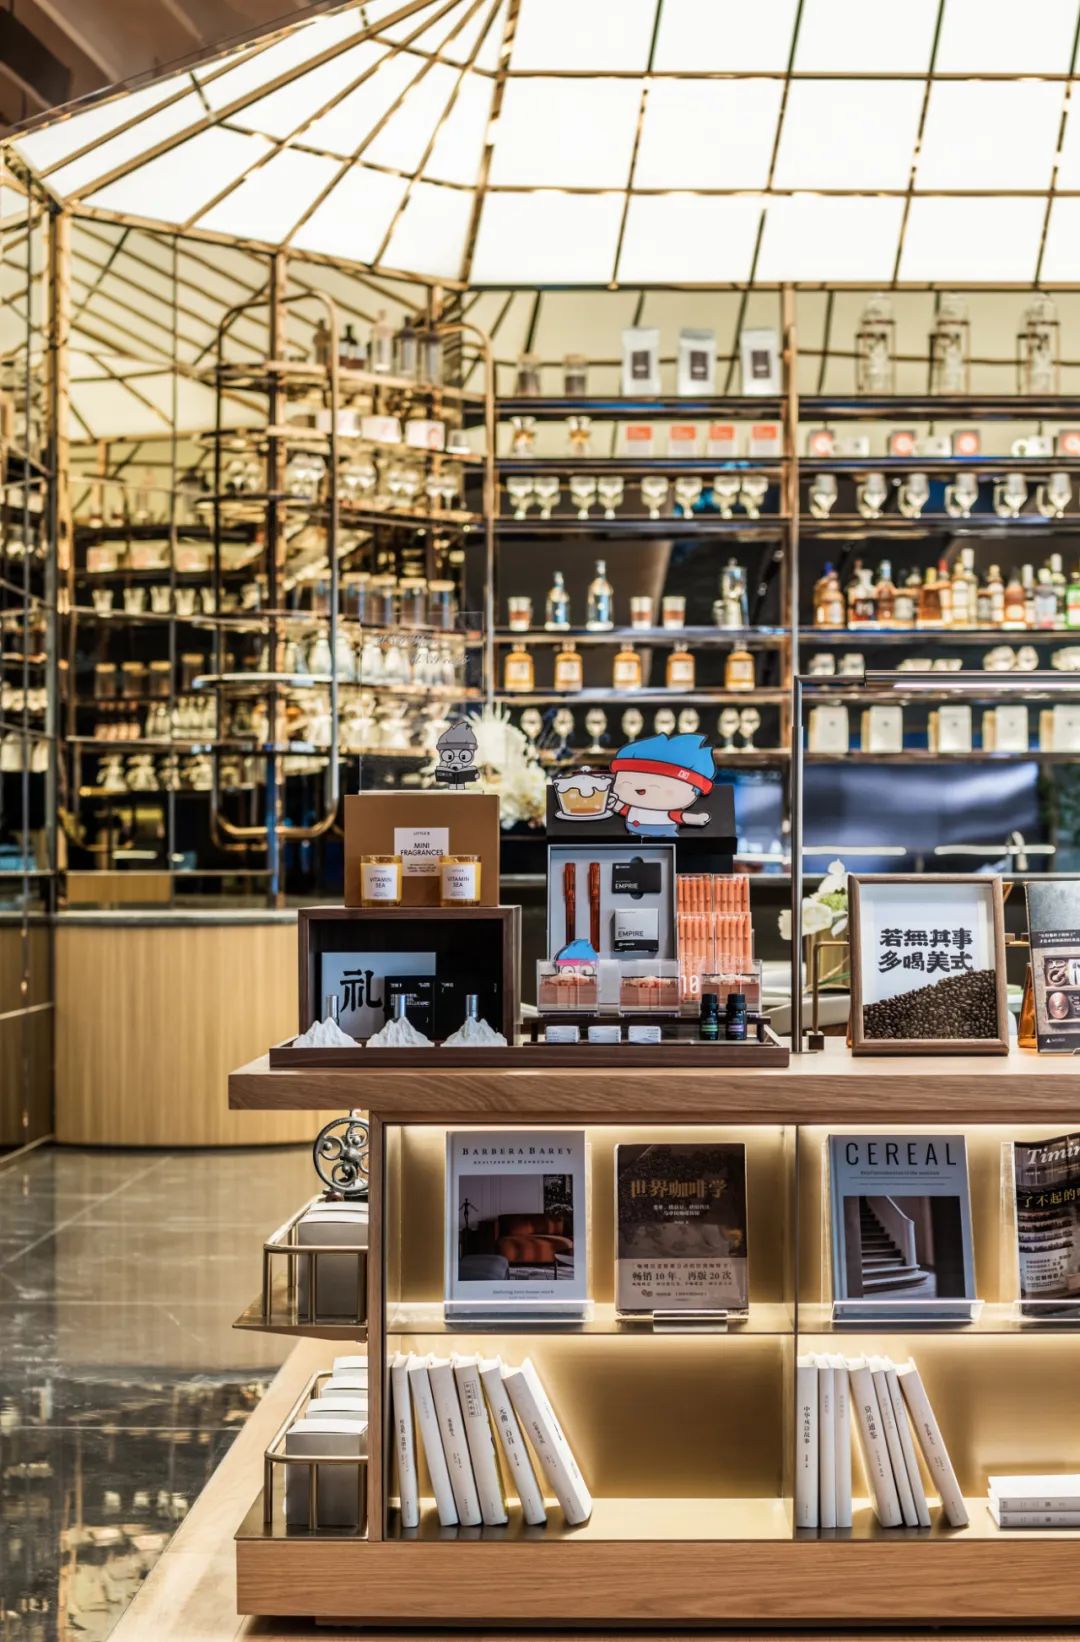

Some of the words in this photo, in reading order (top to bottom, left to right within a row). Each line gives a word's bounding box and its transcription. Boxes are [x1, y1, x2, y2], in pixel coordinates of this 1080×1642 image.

[618, 930, 644, 938] EMPIRE
[879, 927, 974, 950] 若無其事
[878, 950, 974, 974] 多喝美式
[681, 975, 701, 994] 10
[845, 1142, 957, 1166] CEREAL
[631, 1179, 728, 1199] 世界咖啡学
